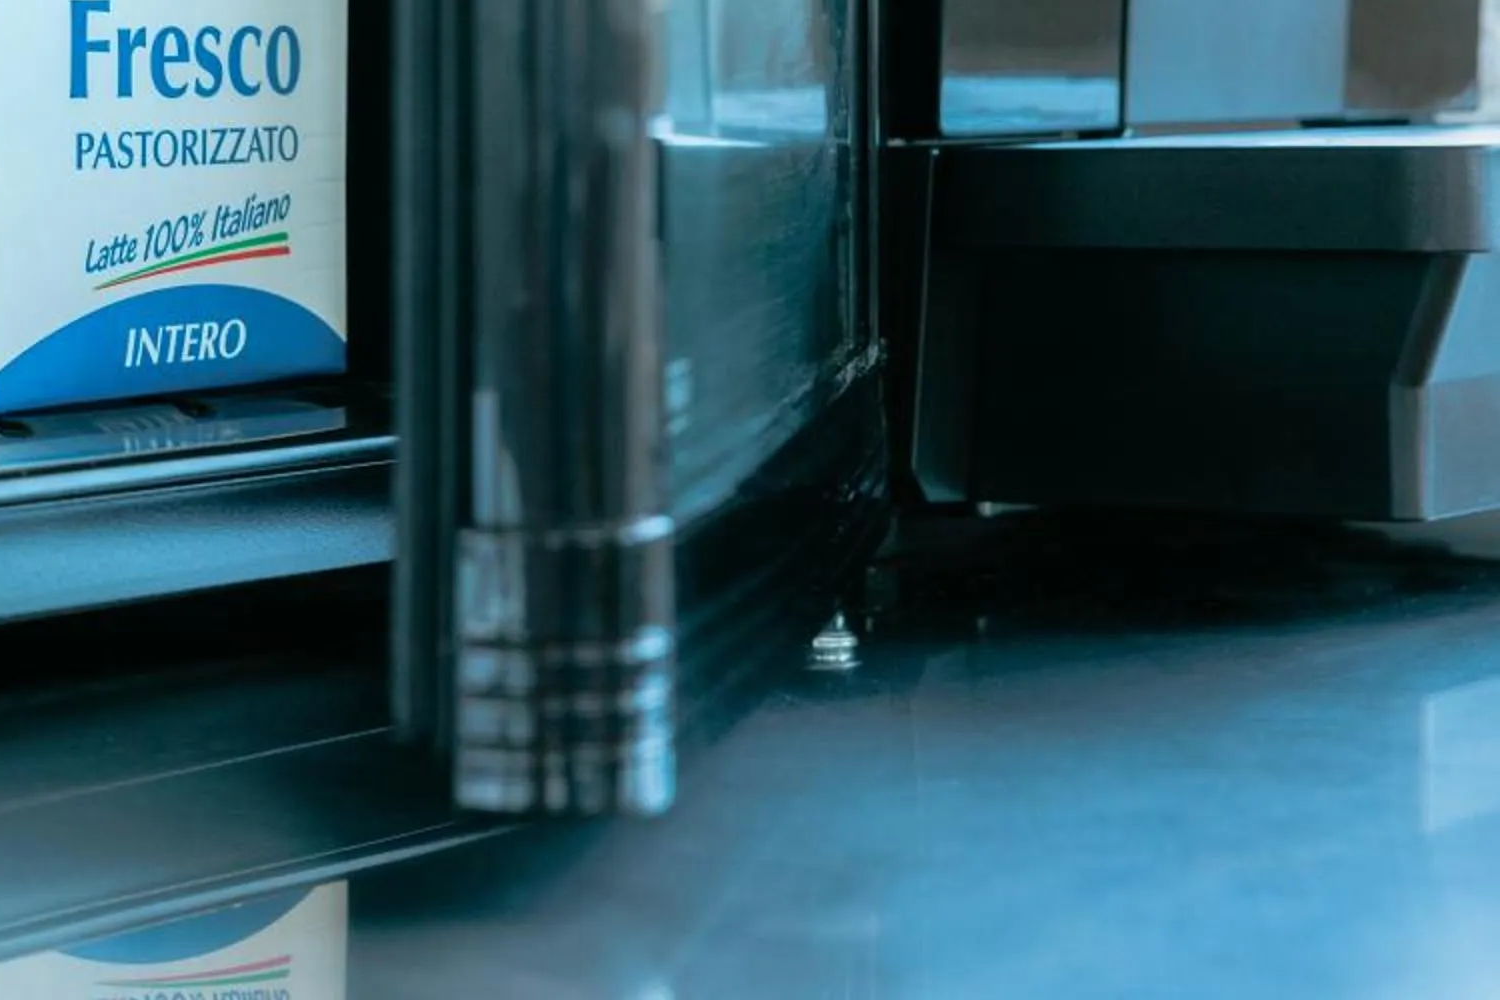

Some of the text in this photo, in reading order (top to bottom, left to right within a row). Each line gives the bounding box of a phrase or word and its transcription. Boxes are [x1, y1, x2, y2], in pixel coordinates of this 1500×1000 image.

[69, 0, 301, 99] Fresco
[75, 125, 299, 171] PASTORIZZATO
[85, 193, 291, 273] Latte 100% Italiano
[124, 318, 247, 368] INTERO
